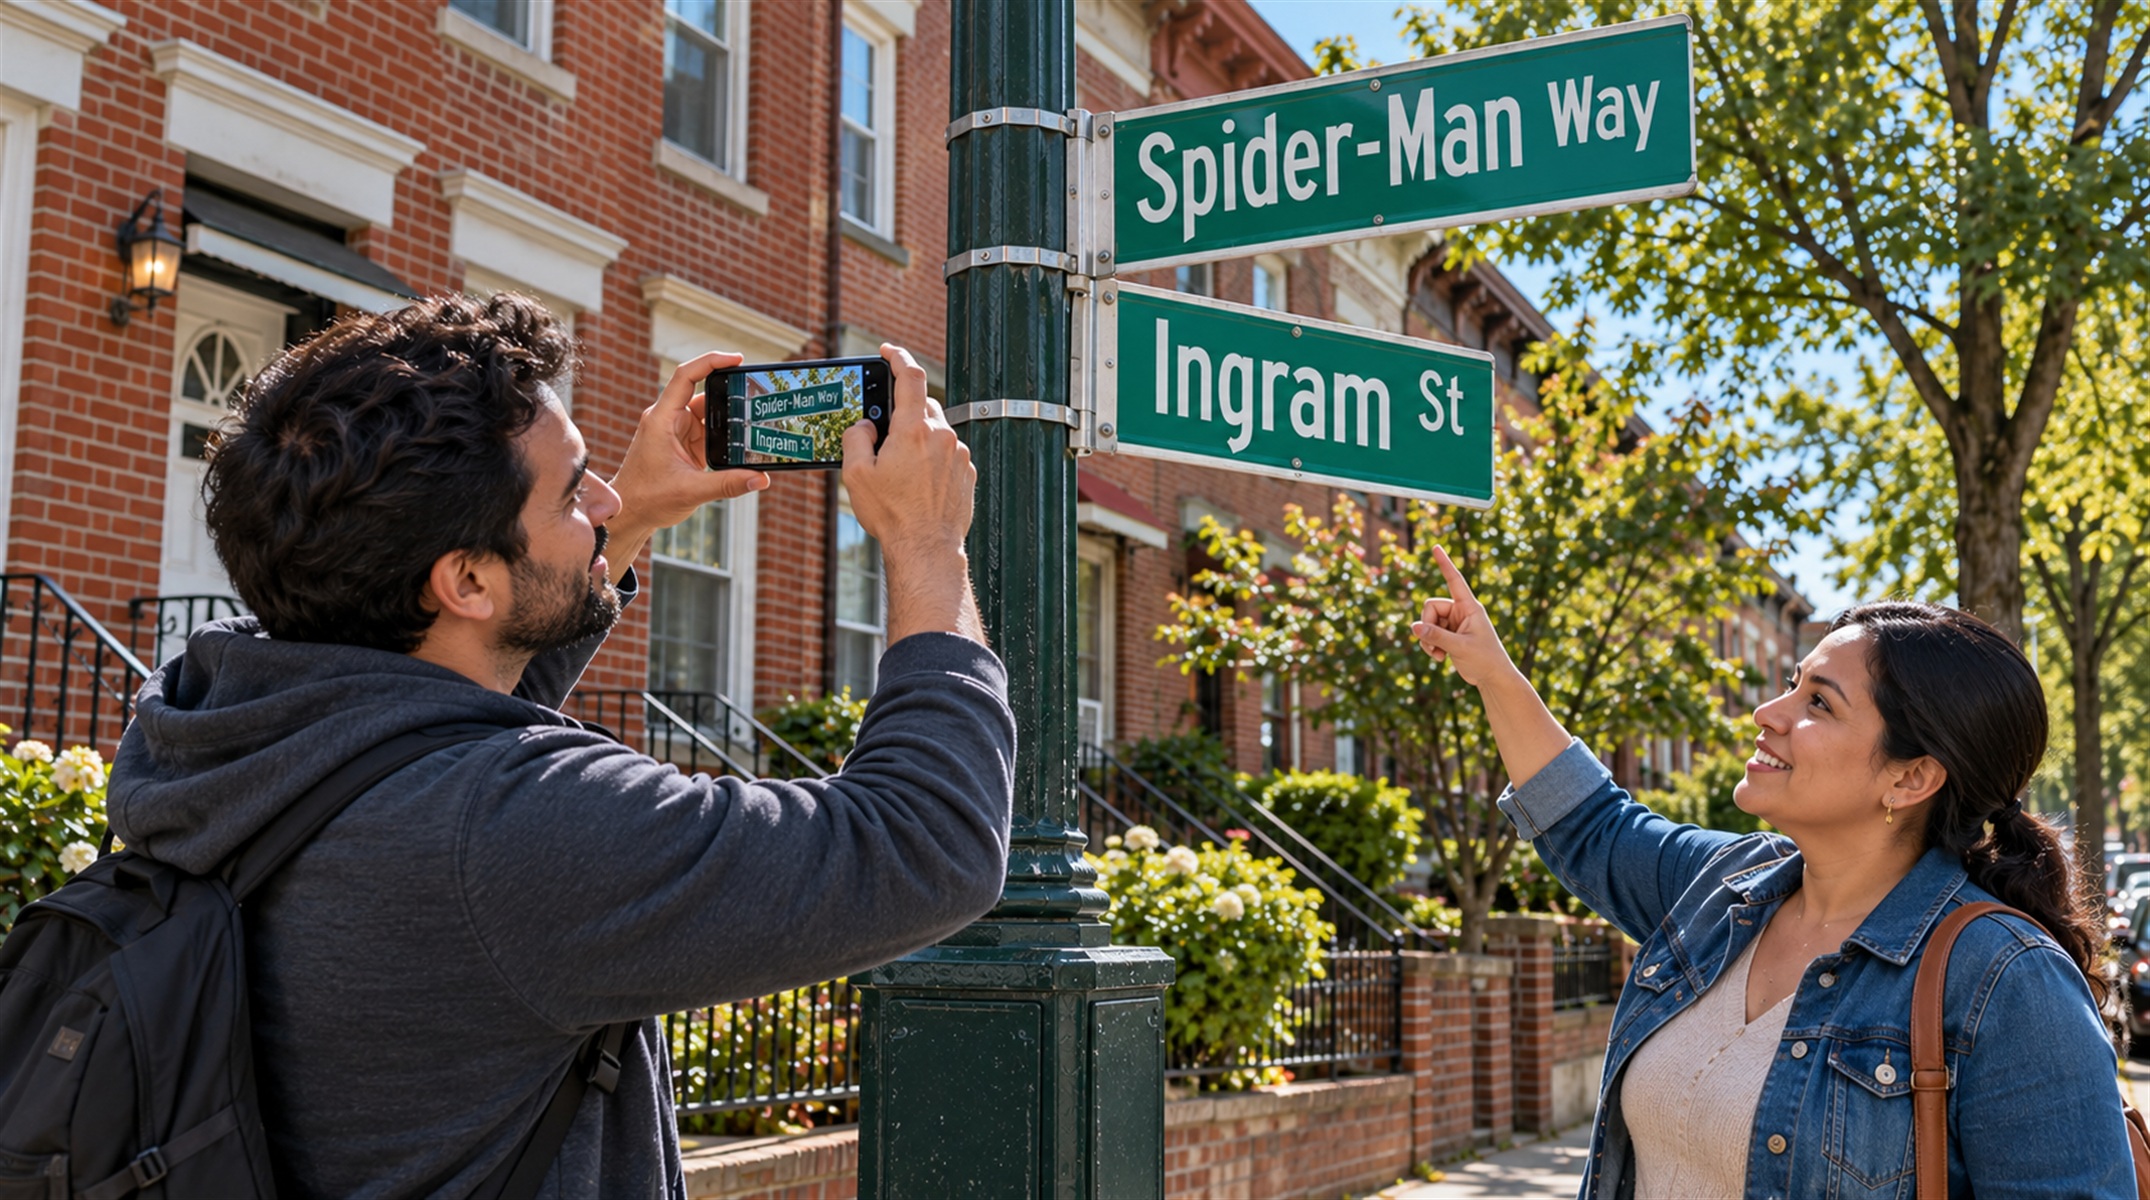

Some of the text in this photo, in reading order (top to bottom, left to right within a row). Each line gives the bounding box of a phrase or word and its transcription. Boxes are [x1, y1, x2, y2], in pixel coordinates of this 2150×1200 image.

[1136, 75, 1660, 243] Spider-Man Way
[754, 392, 815, 418] Spider-Man
[1155, 318, 1465, 454] Ingram St
